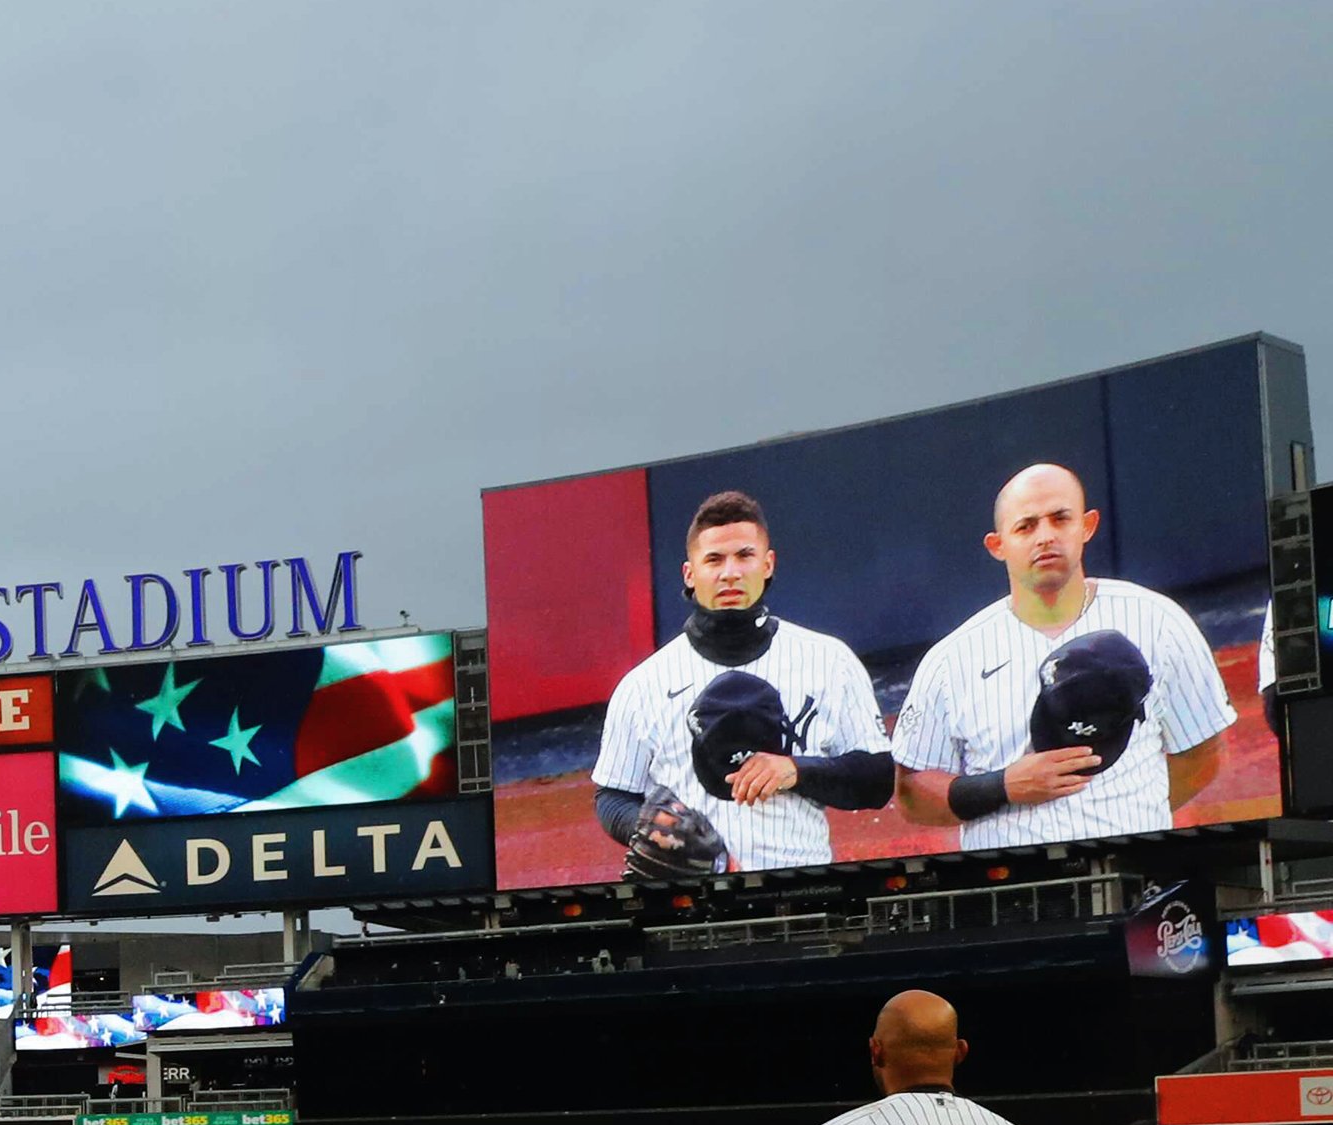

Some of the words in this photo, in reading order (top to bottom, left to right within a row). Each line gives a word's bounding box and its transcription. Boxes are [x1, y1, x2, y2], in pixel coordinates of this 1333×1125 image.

[185, 820, 463, 885] DELTA
[162, 1115, 208, 1125] bet365
[242, 1114, 290, 1125] bet365
